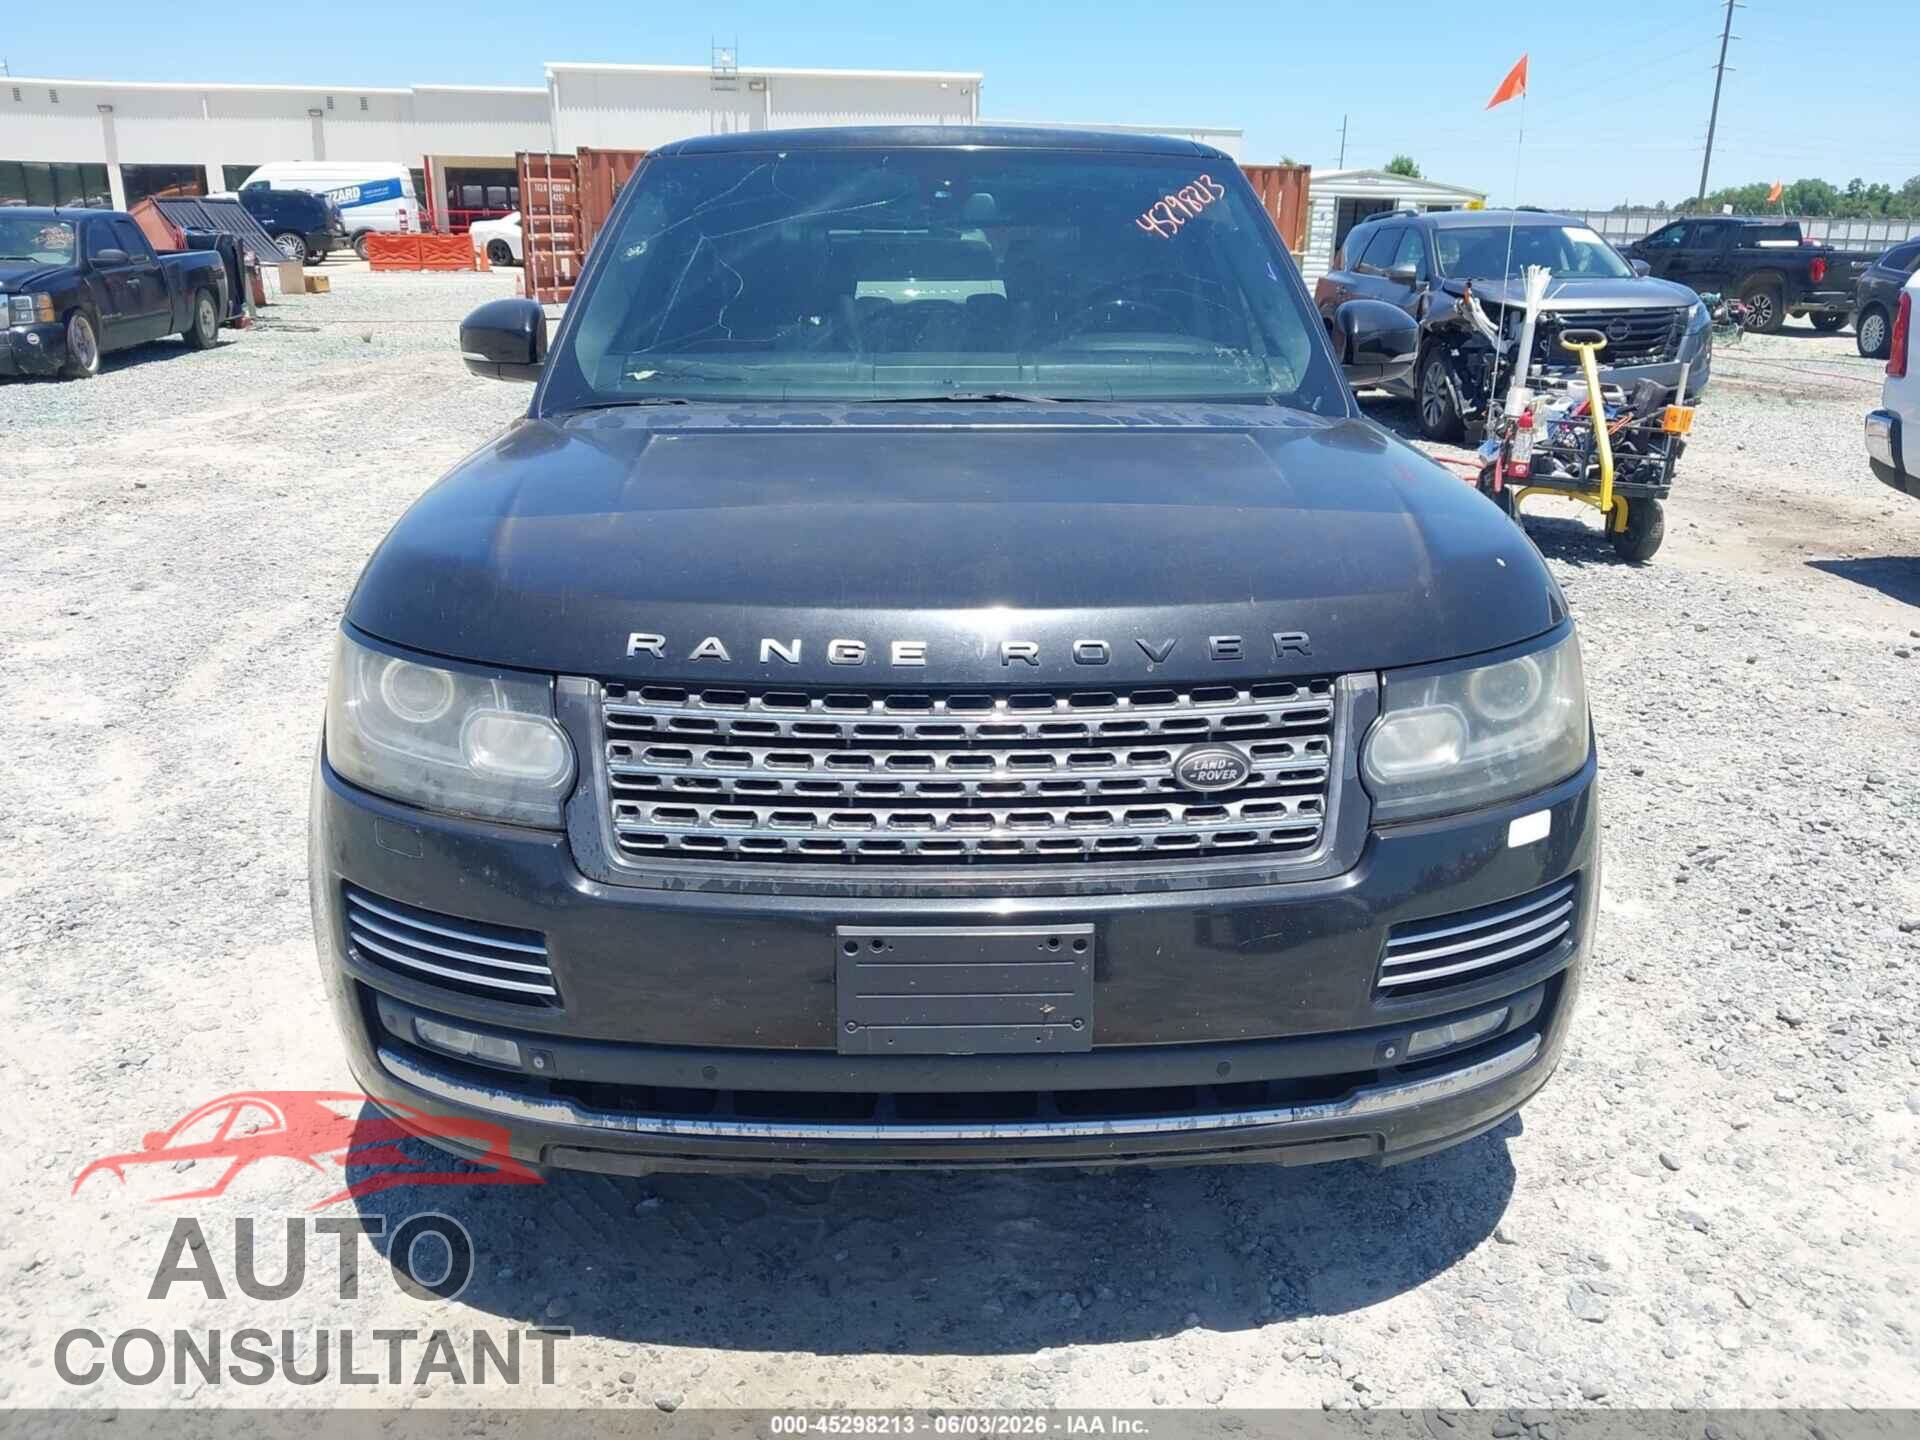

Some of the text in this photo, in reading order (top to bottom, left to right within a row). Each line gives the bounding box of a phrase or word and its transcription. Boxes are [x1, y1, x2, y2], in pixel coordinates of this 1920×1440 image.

[1135, 173, 1225, 239] 45298213
[626, 631, 1313, 667] RANGE ROVER
